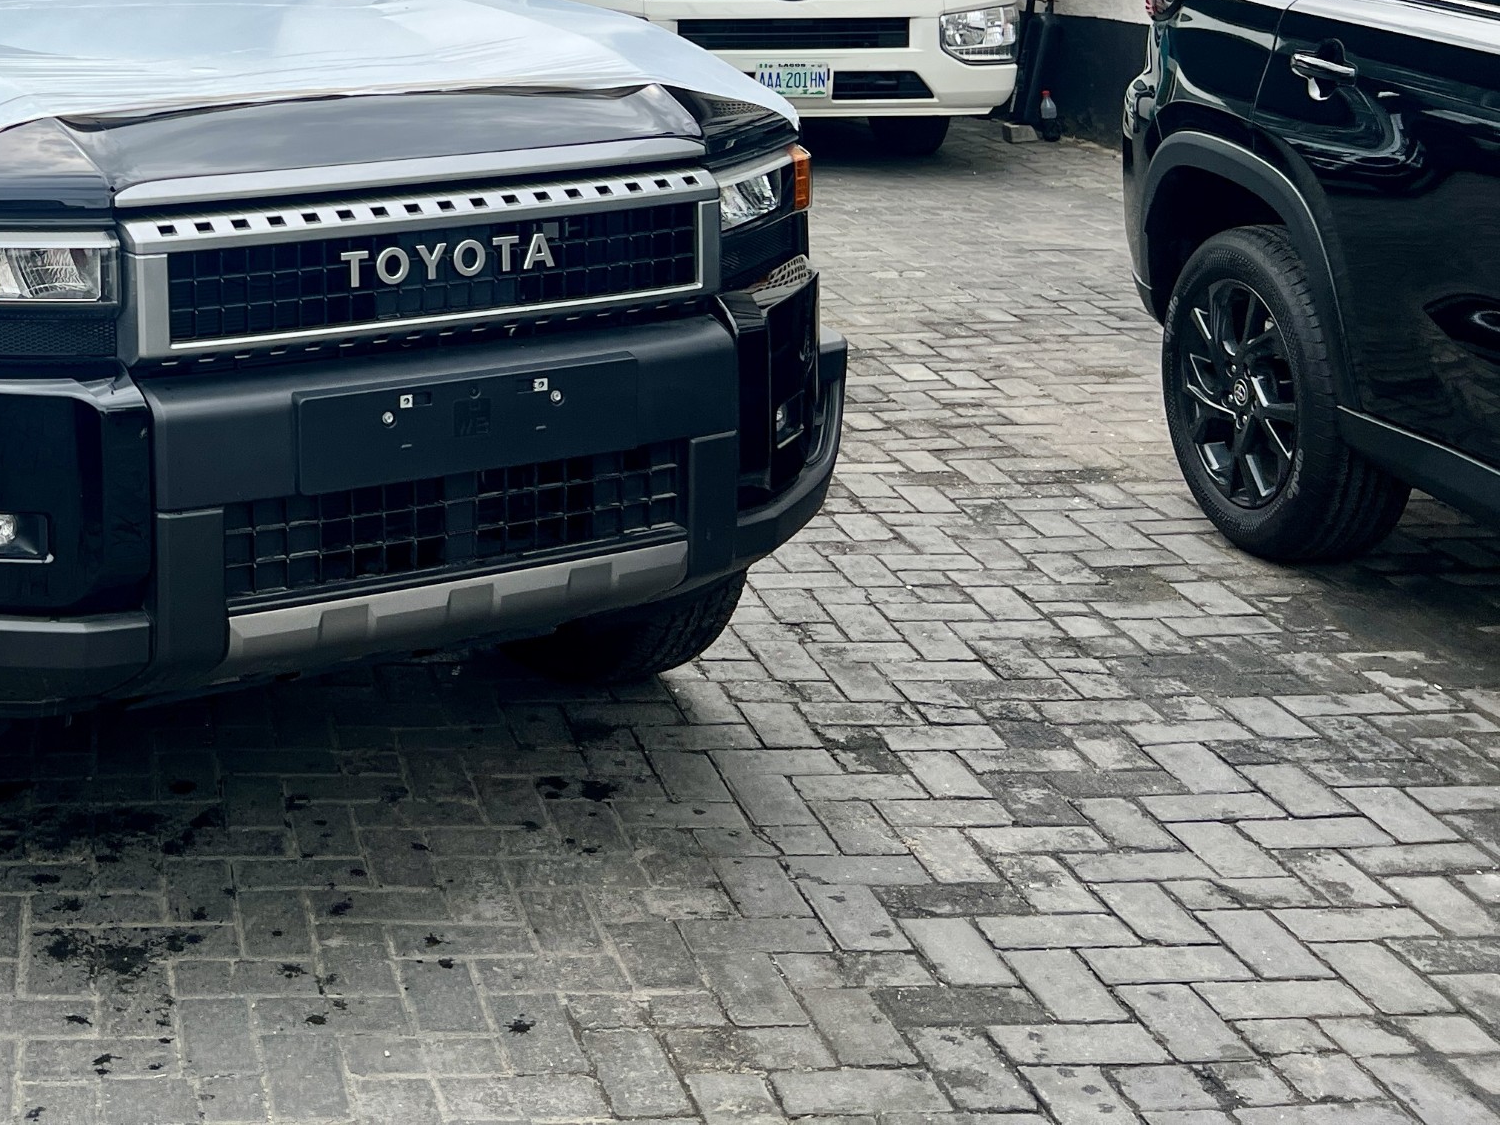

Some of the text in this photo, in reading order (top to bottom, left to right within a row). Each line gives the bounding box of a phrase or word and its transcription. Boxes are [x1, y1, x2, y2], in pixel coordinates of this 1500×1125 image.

[341, 233, 555, 288] TOYOTA
[1165, 295, 1179, 343] apollo
[1287, 448, 1304, 499] apollo
